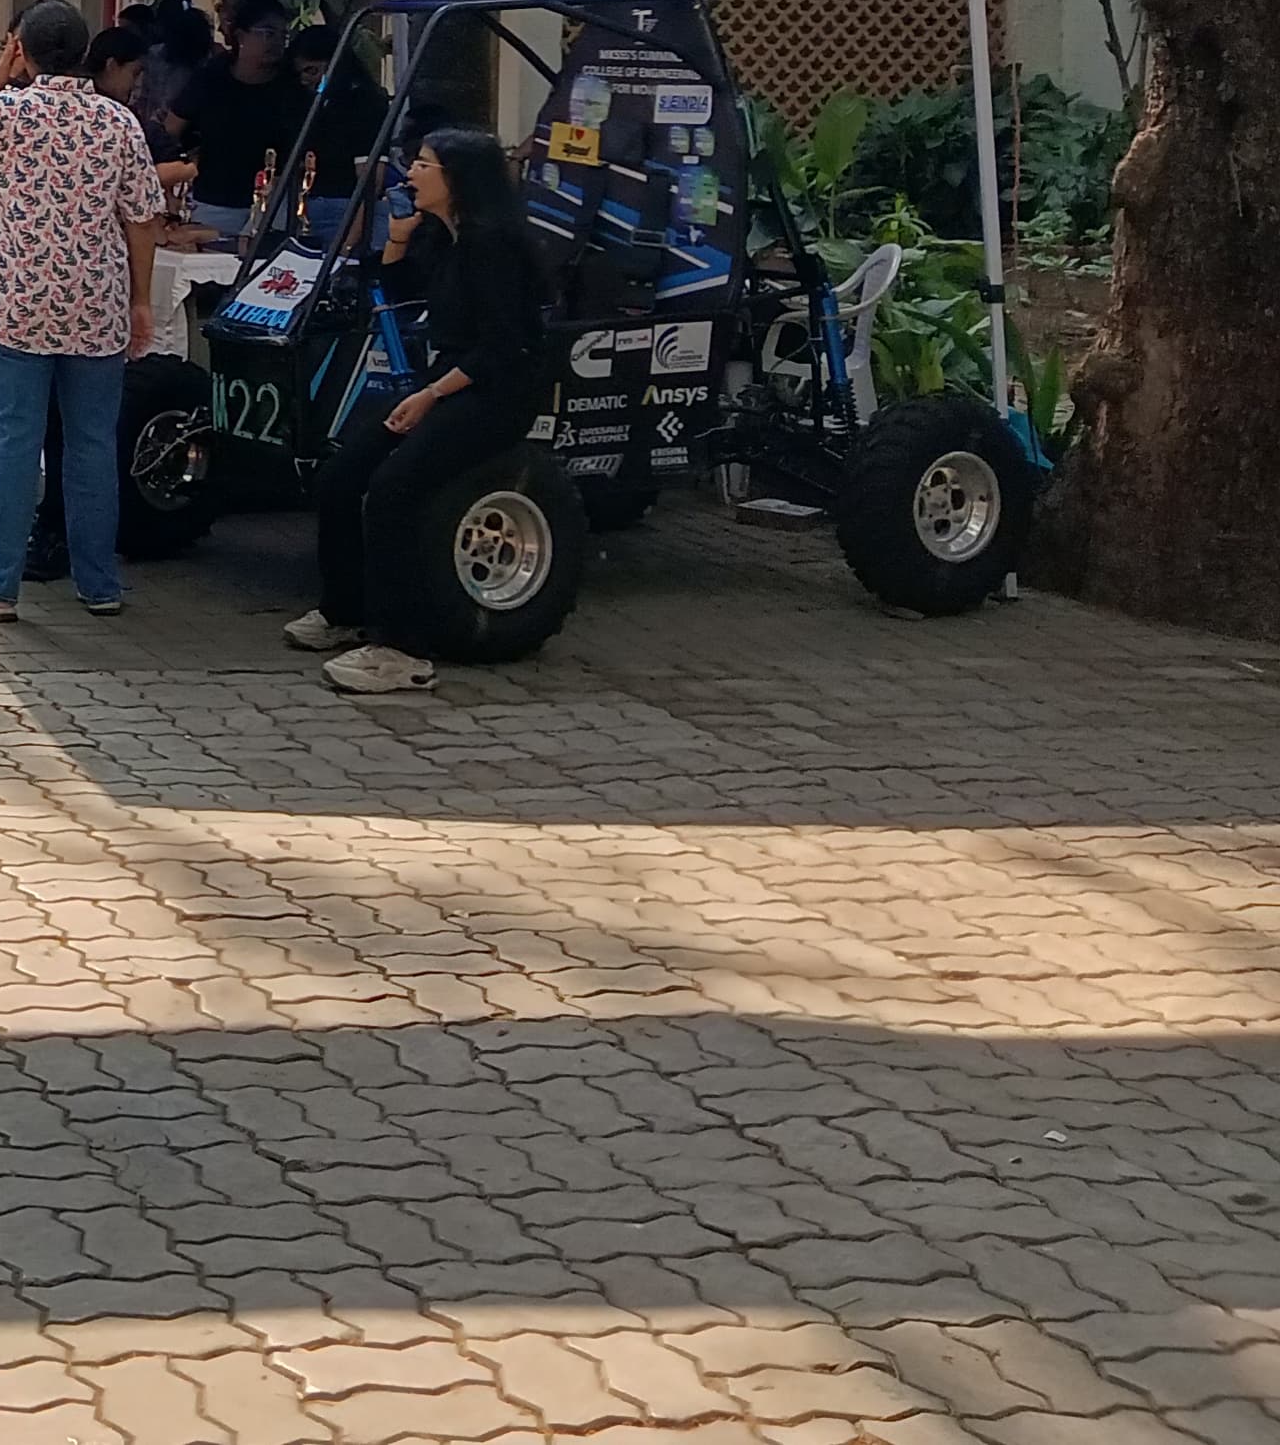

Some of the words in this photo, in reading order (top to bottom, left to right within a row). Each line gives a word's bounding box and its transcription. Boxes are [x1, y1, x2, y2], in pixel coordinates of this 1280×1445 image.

[220, 301, 293, 329] ATHENA
[567, 395, 628, 412] DEMATIC
[641, 385, 708, 406] Ansys
